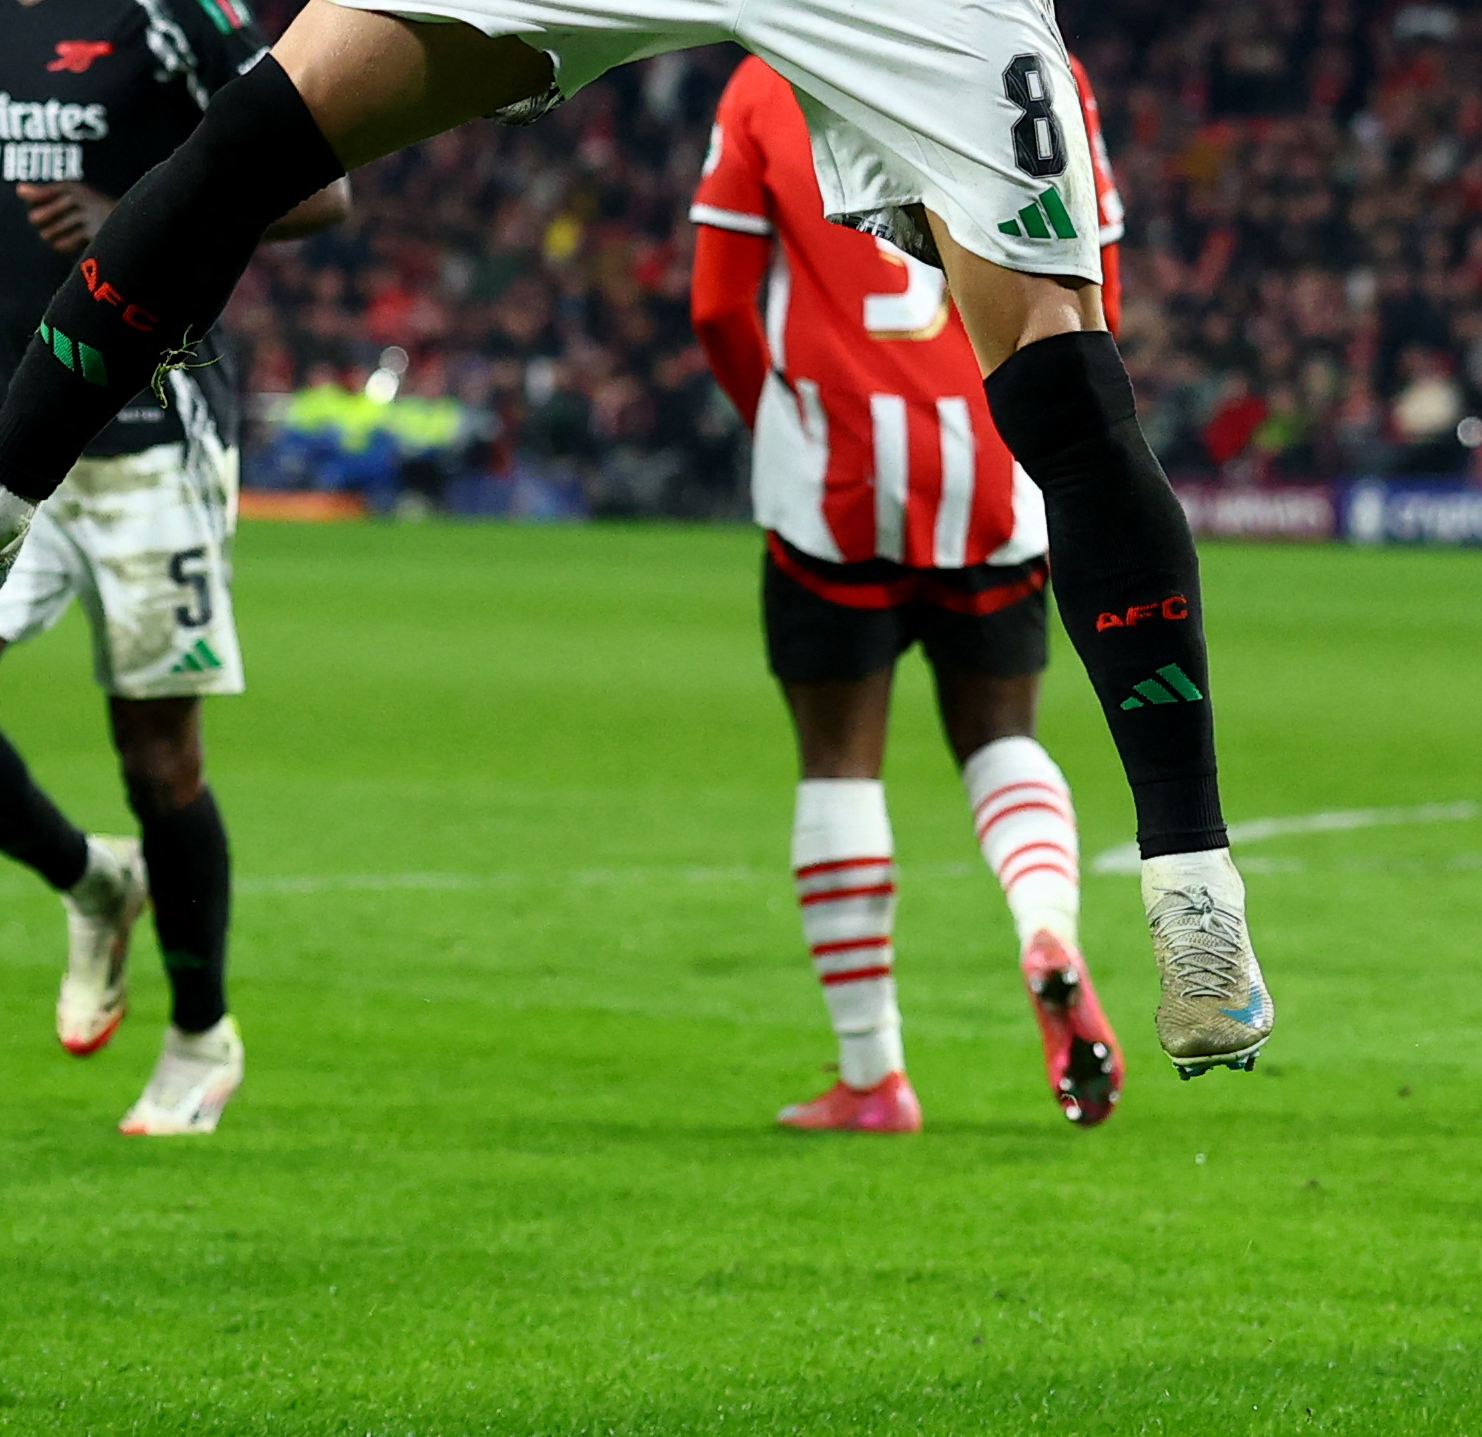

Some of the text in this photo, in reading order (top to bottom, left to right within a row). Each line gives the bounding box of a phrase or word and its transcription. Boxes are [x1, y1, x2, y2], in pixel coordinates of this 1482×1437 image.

[1002, 51, 1068, 180] 8
[3, 141, 85, 181] BETTER
[80, 258, 160, 332] AFC
[170, 548, 213, 628] 5
[1096, 596, 1188, 632] AFC
